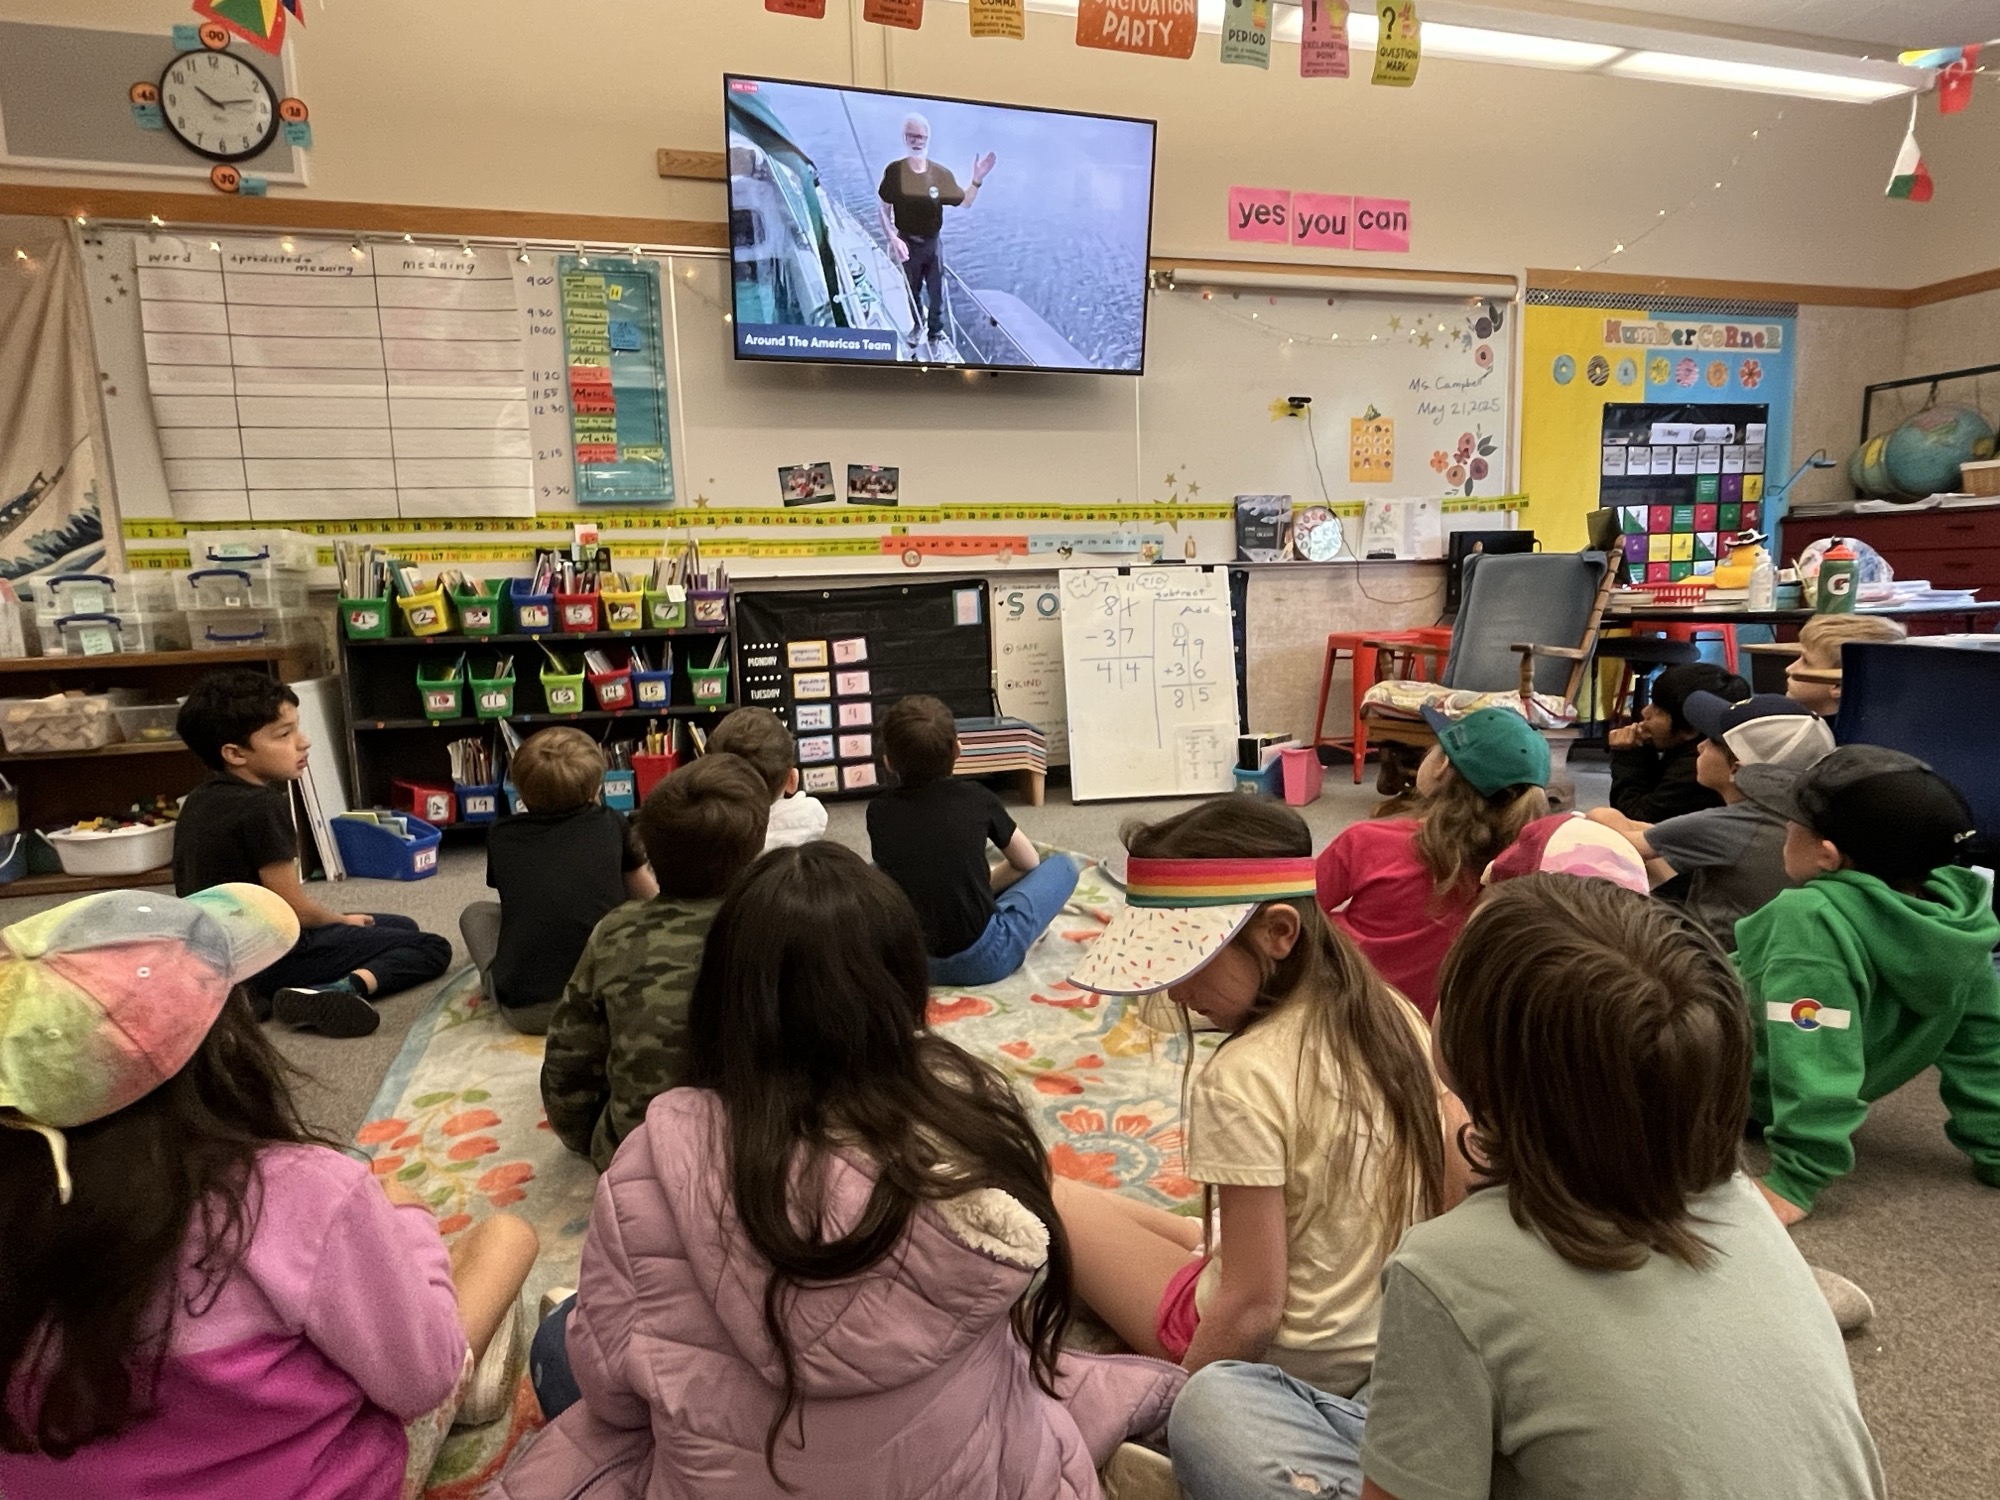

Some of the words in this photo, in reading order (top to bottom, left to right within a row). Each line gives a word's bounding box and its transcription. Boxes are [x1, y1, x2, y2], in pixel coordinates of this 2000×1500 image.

[1102, 10, 1174, 47] PARTY
[1228, 29, 1266, 46] PERIOD
[1316, 51, 1336, 59] POINT
[1380, 47, 1418, 59] QUESTION
[187, 59, 197, 73] 11
[208, 56, 218, 69] 12
[1386, 61, 1408, 71] MARK
[235, 65, 239, 76] 1
[172, 72, 184, 84] 10
[252, 80, 260, 93] 2
[169, 94, 176, 106] 9
[179, 116, 186, 129] 8
[256, 123, 263, 134] 4
[197, 132, 204, 144] 7
[243, 136, 250, 149] 5
[219, 140, 227, 153] 6
[1238, 202, 1286, 228] yes
[1298, 212, 1346, 238] you
[1358, 209, 1407, 231] can
[567, 324, 605, 335] Calendar
[1605, 319, 1697, 346] Number
[745, 333, 785, 346] Around
[788, 335, 808, 347] The
[810, 337, 860, 349] Americas
[862, 339, 891, 350] Team
[577, 404, 614, 414] Library
[1418, 402, 1445, 425] May
[580, 433, 613, 442] Math
[444, 521, 452, 530] 20
[475, 521, 483, 530] 22
[506, 521, 514, 530] 24
[536, 521, 545, 529] 26
[566, 521, 574, 529] 28
[624, 519, 632, 527] 32
[653, 519, 661, 527] 34
[680, 517, 688, 525] 36
[707, 517, 715, 525] 38
[762, 516, 770, 524] 42
[816, 517, 823, 525] 46
[317, 525, 325, 533] 12
[349, 524, 358, 533] 14
[382, 523, 390, 532] 16
[413, 522, 421, 531] 18
[1127, 582, 1134, 592] 11
[1827, 573, 1850, 595] G
[1155, 589, 1205, 598] subtract
[1007, 592, 1024, 616] S
[1037, 593, 1060, 616] O
[418, 611, 429, 622] 2
[527, 608, 536, 620] 4
[572, 608, 583, 619] 5
[661, 606, 672, 618] 7
[1180, 606, 1211, 616] Add
[473, 612, 482, 622] 3
[748, 656, 777, 667] MONDAY
[701, 682, 716, 695] 16
[847, 679, 856, 689] 5
[1015, 678, 1042, 688] KIND
[556, 690, 570, 703] 13
[604, 686, 618, 698] 14
[644, 685, 658, 698] 15
[751, 688, 780, 700] TUESDAY
[849, 708, 857, 719] 4
[850, 740, 859, 750] 3
[854, 771, 863, 782] 2
[473, 800, 487, 811] 19
[420, 854, 431, 865] 18
